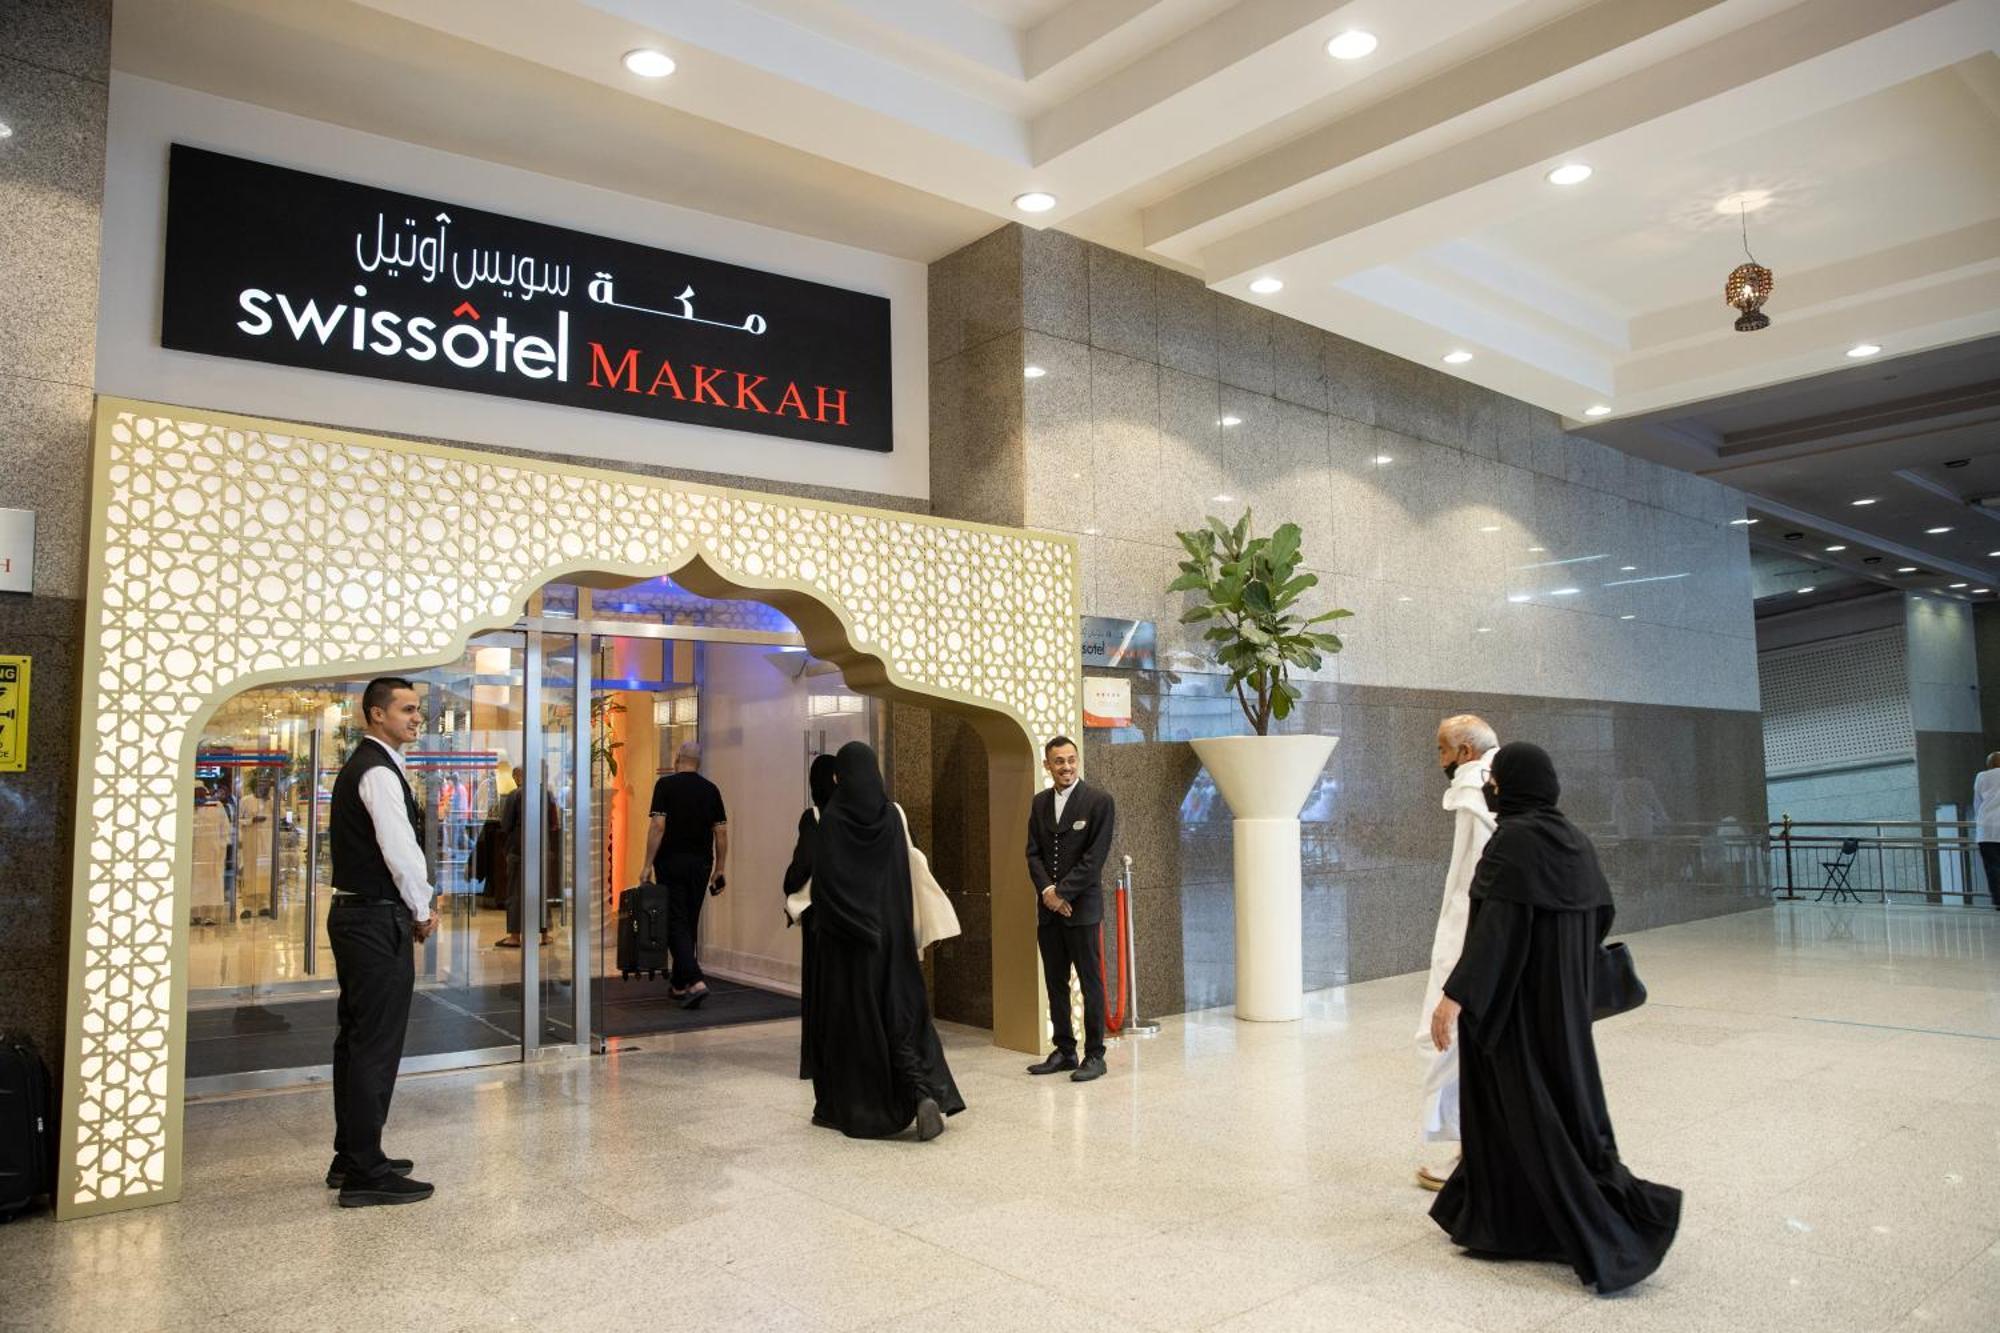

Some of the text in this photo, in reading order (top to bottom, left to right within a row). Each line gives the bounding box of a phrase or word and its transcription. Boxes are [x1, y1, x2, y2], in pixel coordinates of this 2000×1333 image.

[453, 249, 571, 301] سويس
[588, 270, 768, 335] مكة
[237, 284, 849, 426] swissôtel MAKKAH
